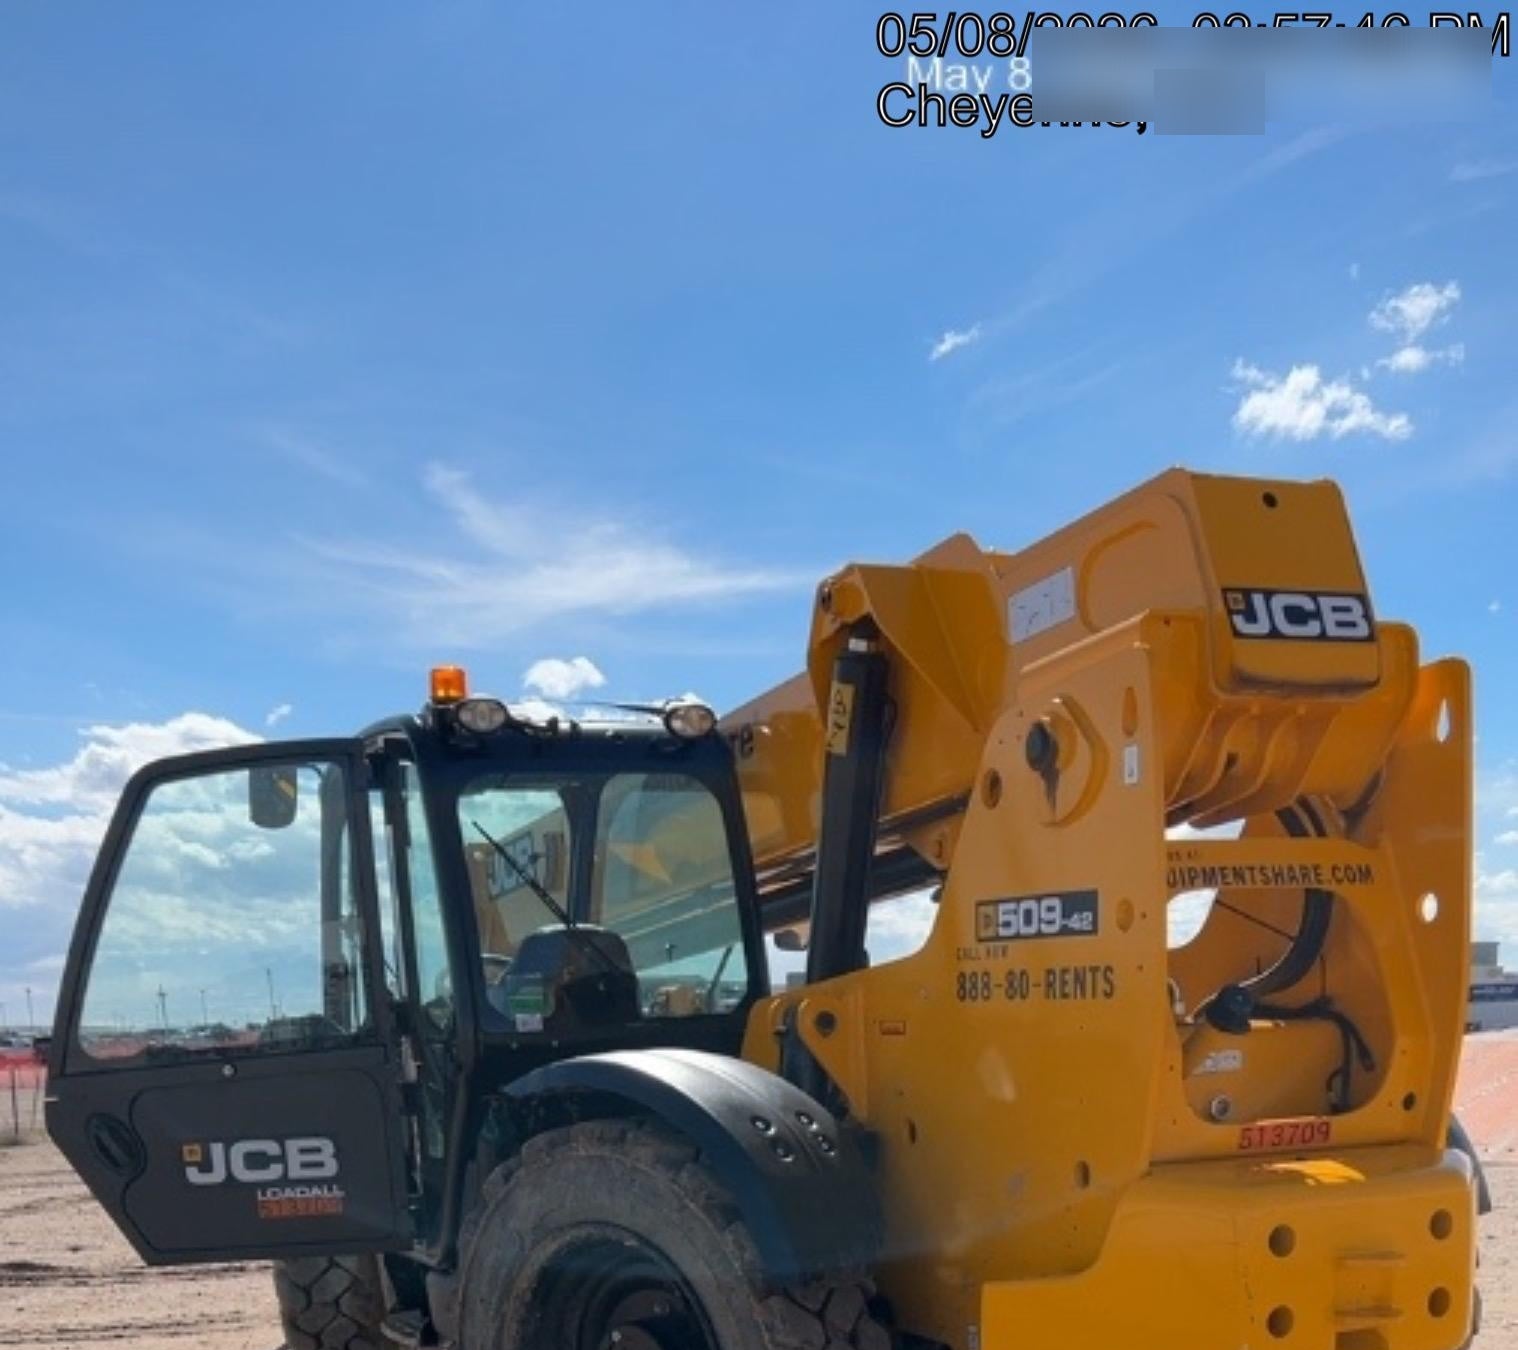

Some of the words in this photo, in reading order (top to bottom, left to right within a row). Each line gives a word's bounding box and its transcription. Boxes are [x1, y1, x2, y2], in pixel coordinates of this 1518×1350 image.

[1232, 593, 1370, 638] JCB
[1166, 864, 1374, 888] UIPMENTSHARE.COM
[998, 897, 1093, 937] 509-42
[956, 965, 1114, 1002] 888-80-RENTS
[185, 1137, 338, 1185] JCB
